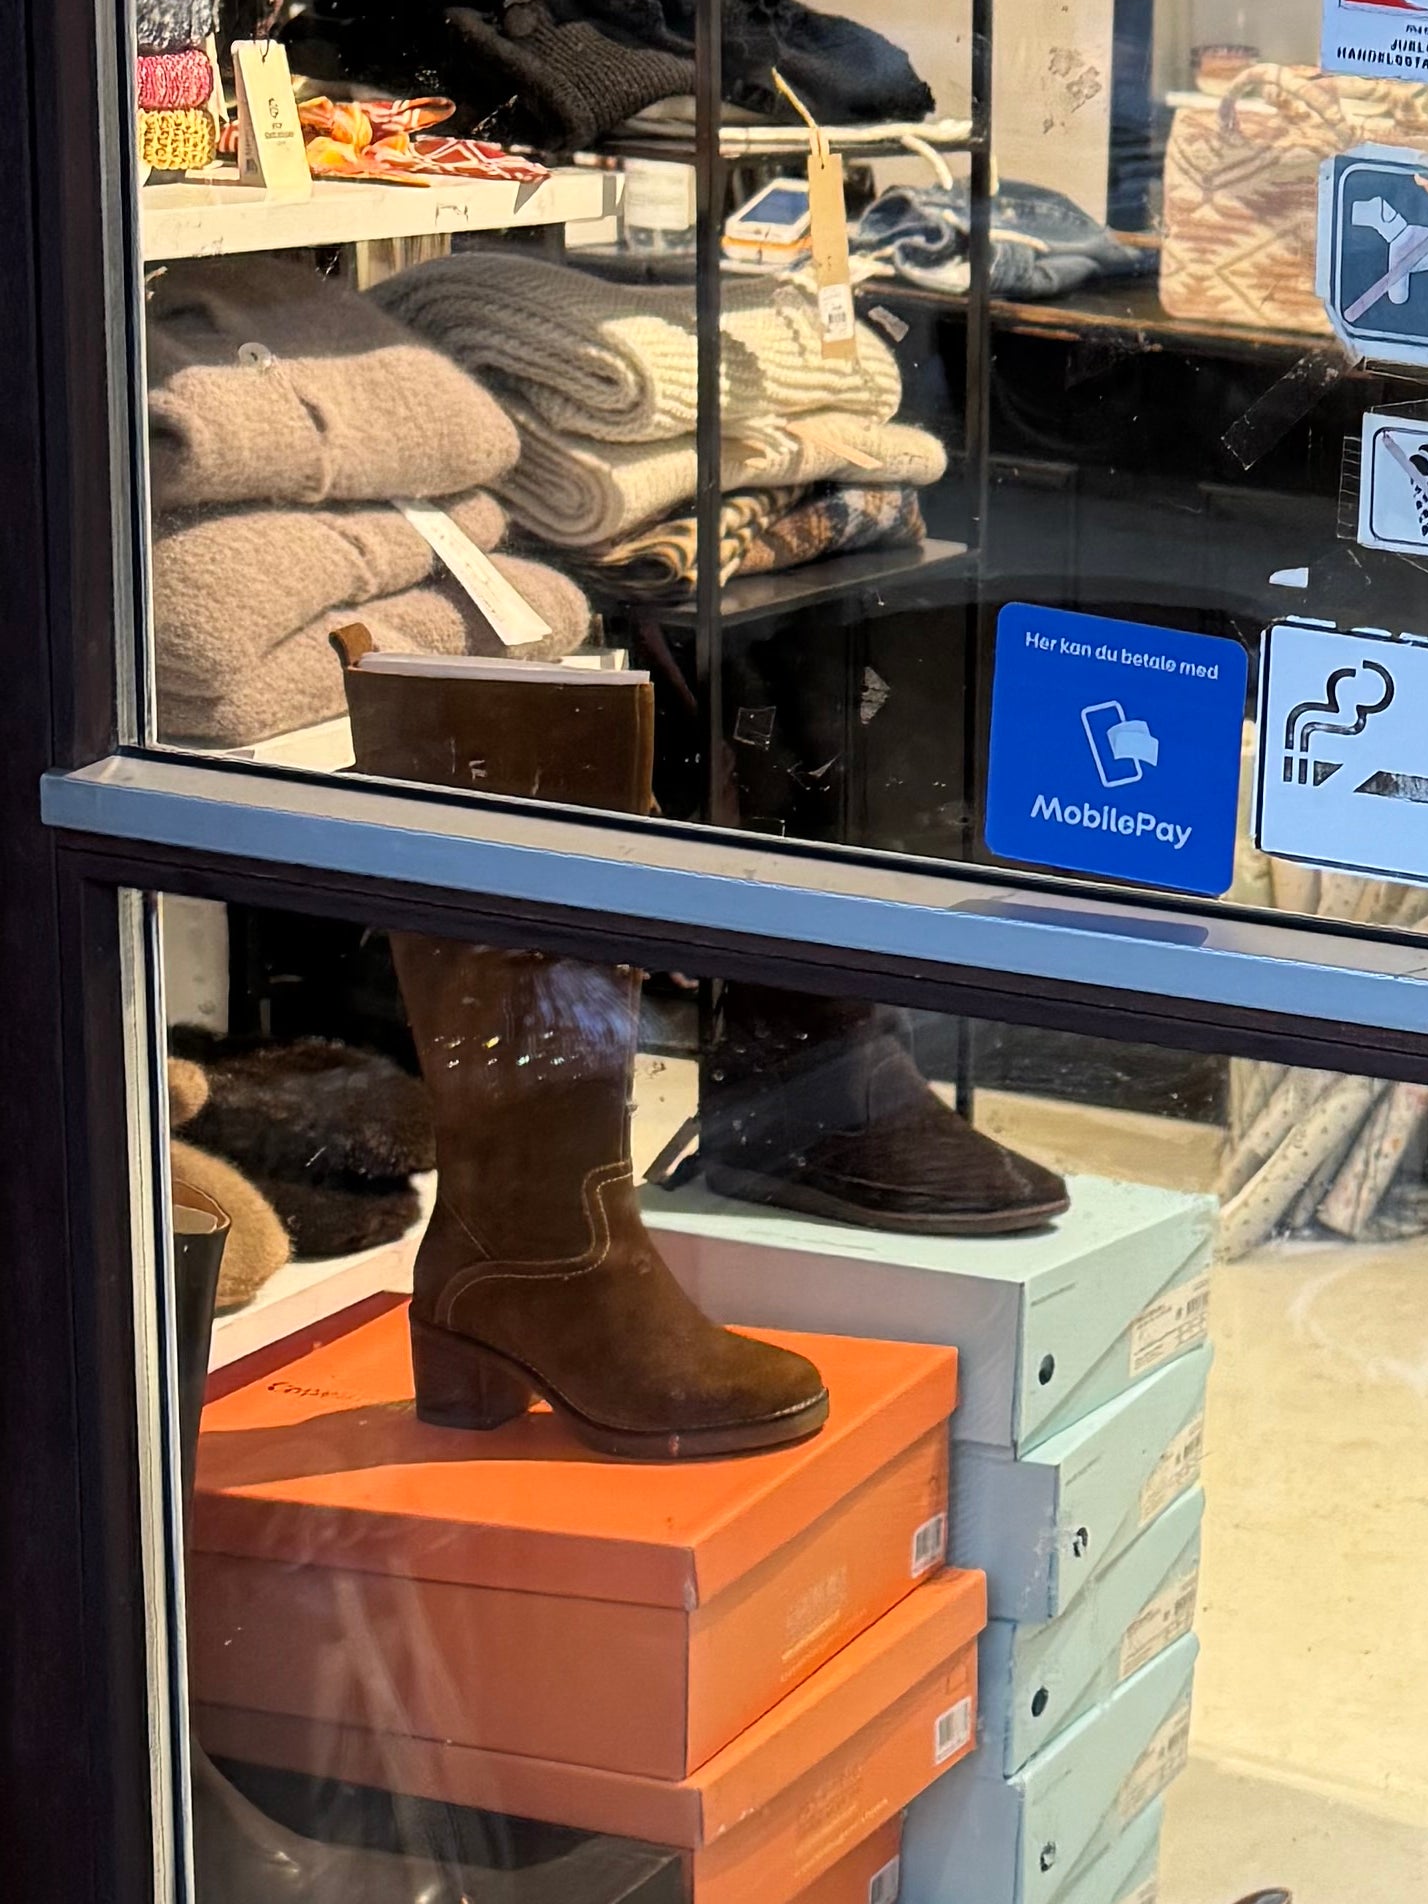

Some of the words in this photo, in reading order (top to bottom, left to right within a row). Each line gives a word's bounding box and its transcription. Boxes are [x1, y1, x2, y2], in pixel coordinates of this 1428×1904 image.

[1025, 631, 1057, 651] Her
[1060, 637, 1092, 658] kan
[1095, 644, 1118, 663] du
[1121, 648, 1177, 673] betale
[1180, 664, 1219, 680] med
[1030, 794, 1193, 850] MobilePay
